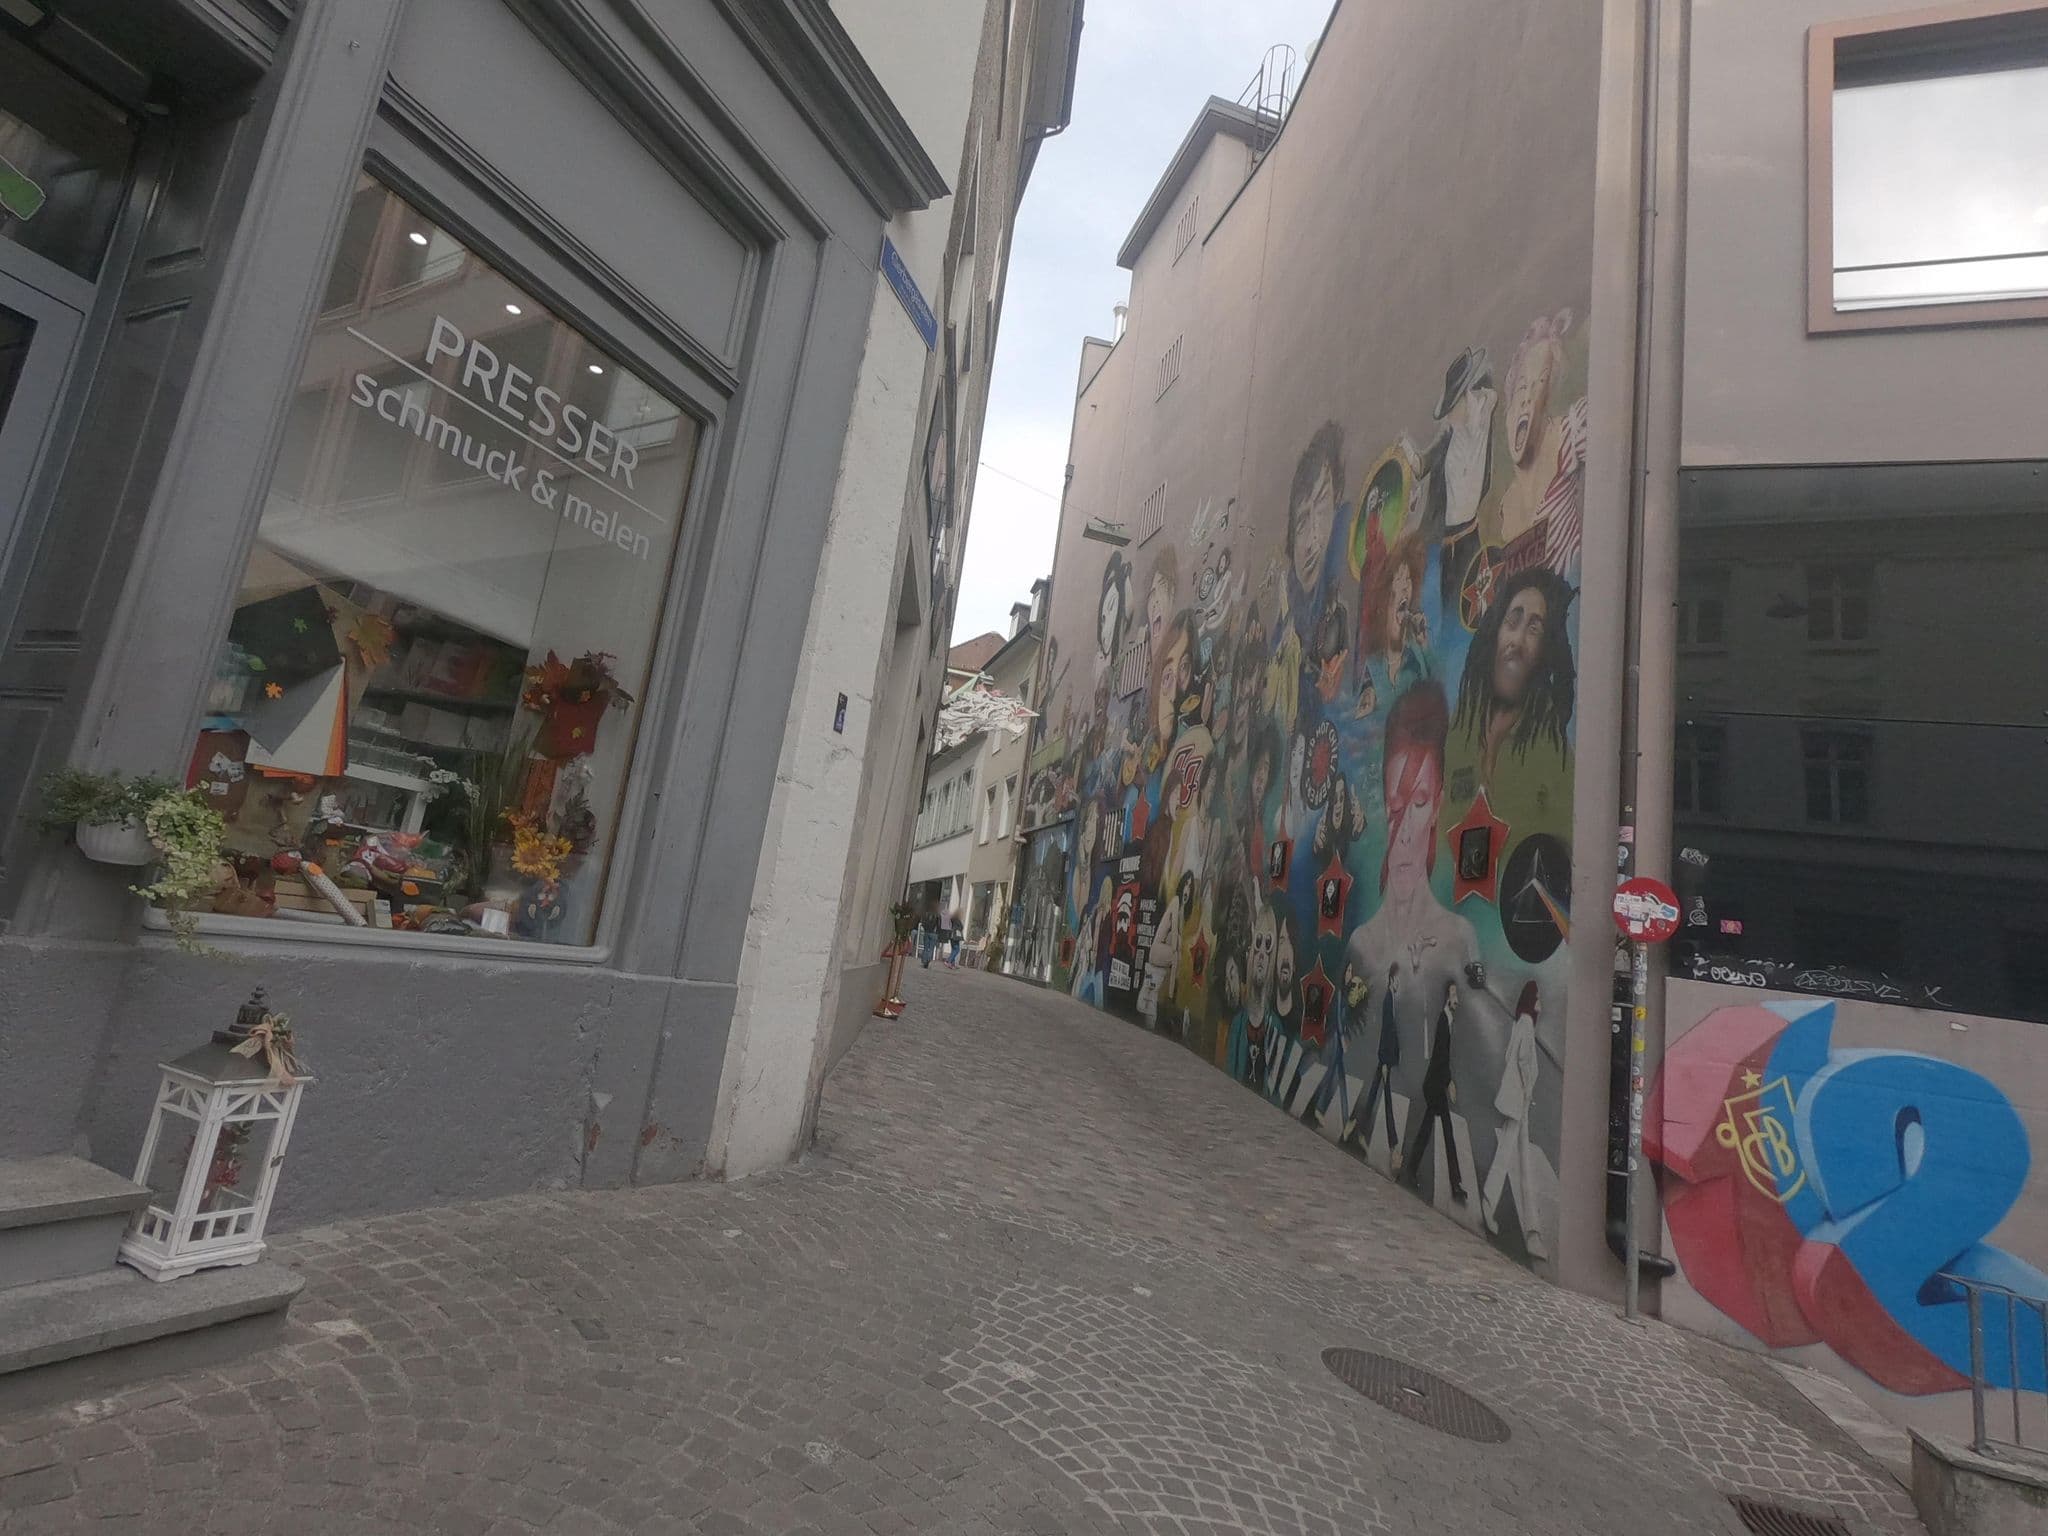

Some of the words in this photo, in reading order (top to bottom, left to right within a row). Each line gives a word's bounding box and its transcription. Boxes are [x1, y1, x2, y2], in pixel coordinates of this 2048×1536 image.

[351, 372, 526, 492] schmuck
[531, 469, 556, 510] &
[563, 493, 651, 561] malen
[425, 315, 639, 490] PRESSER
